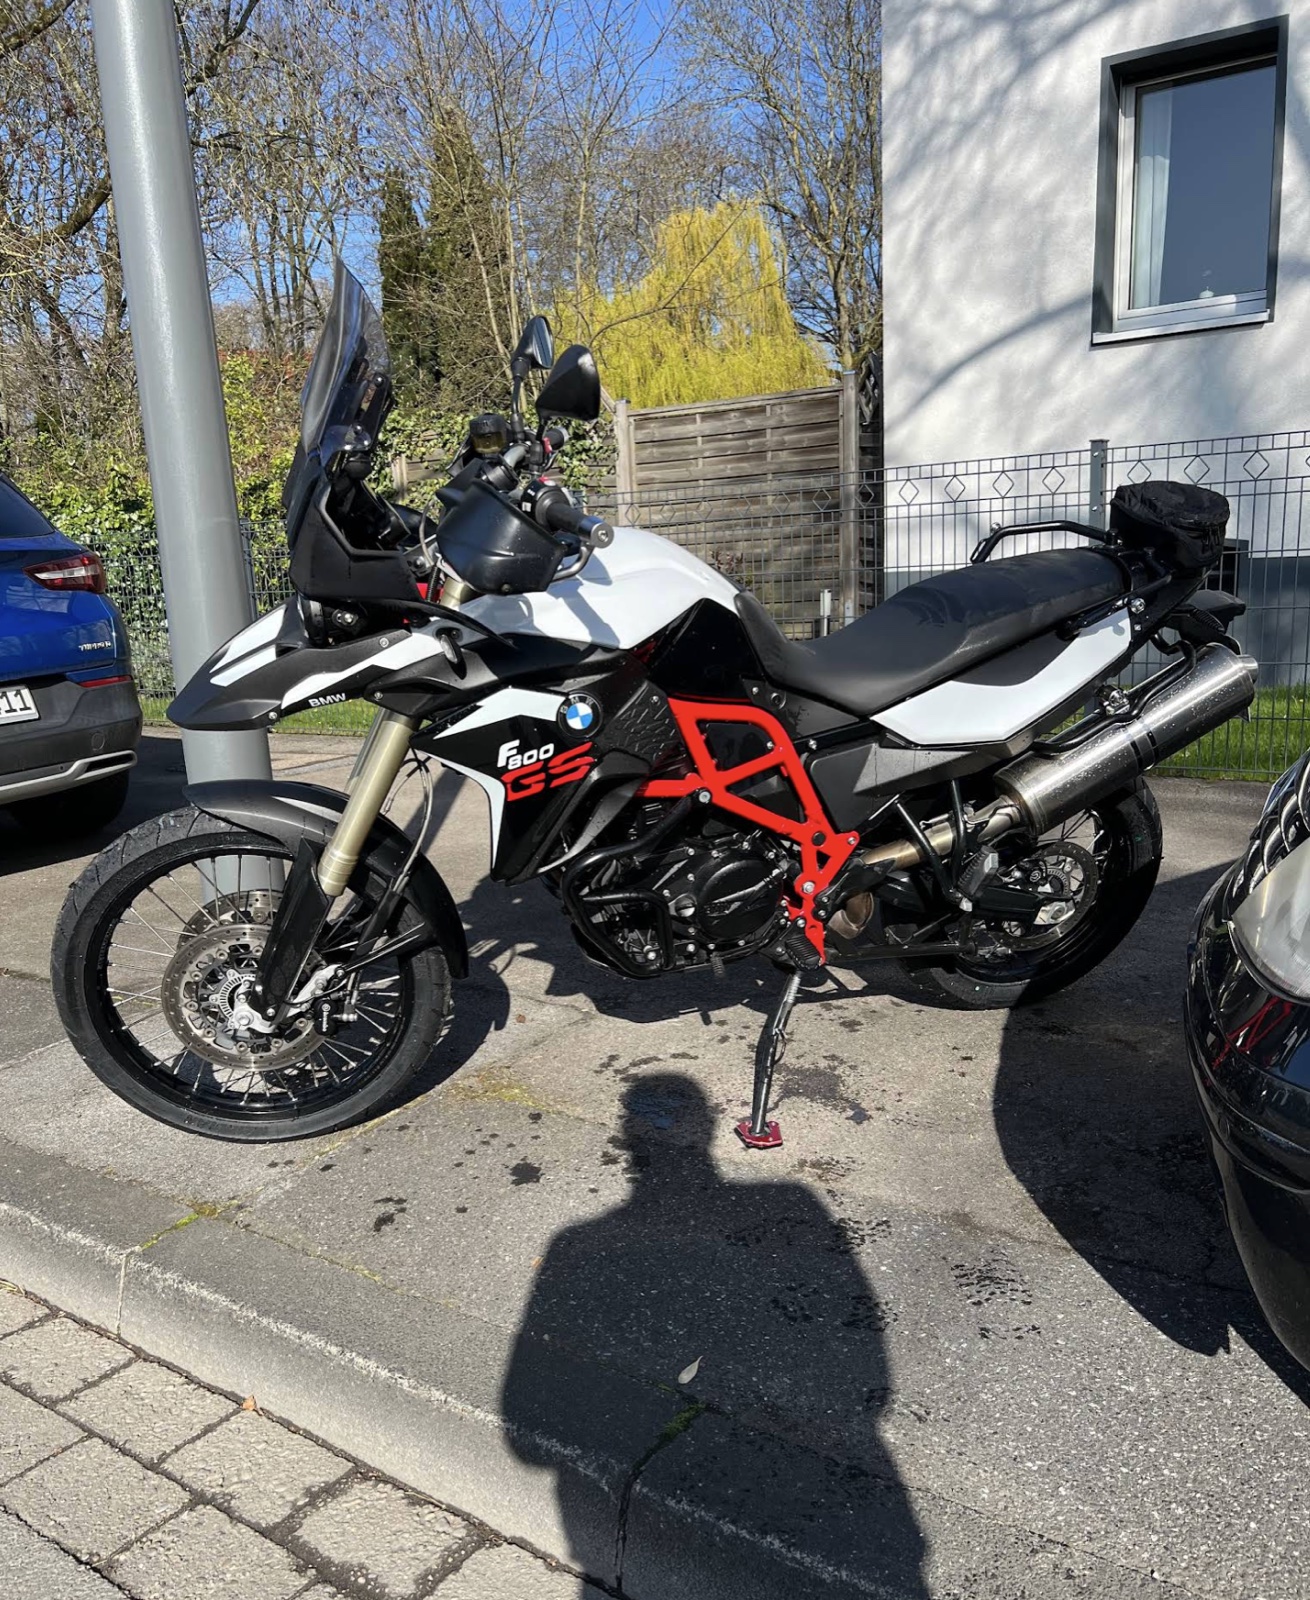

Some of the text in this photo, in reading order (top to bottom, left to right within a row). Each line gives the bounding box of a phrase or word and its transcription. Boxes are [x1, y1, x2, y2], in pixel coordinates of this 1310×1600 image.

[0, 690, 32, 715] 11
[308, 692, 346, 707] BMW
[560, 695, 595, 715] BMW
[500, 741, 595, 801] GS
